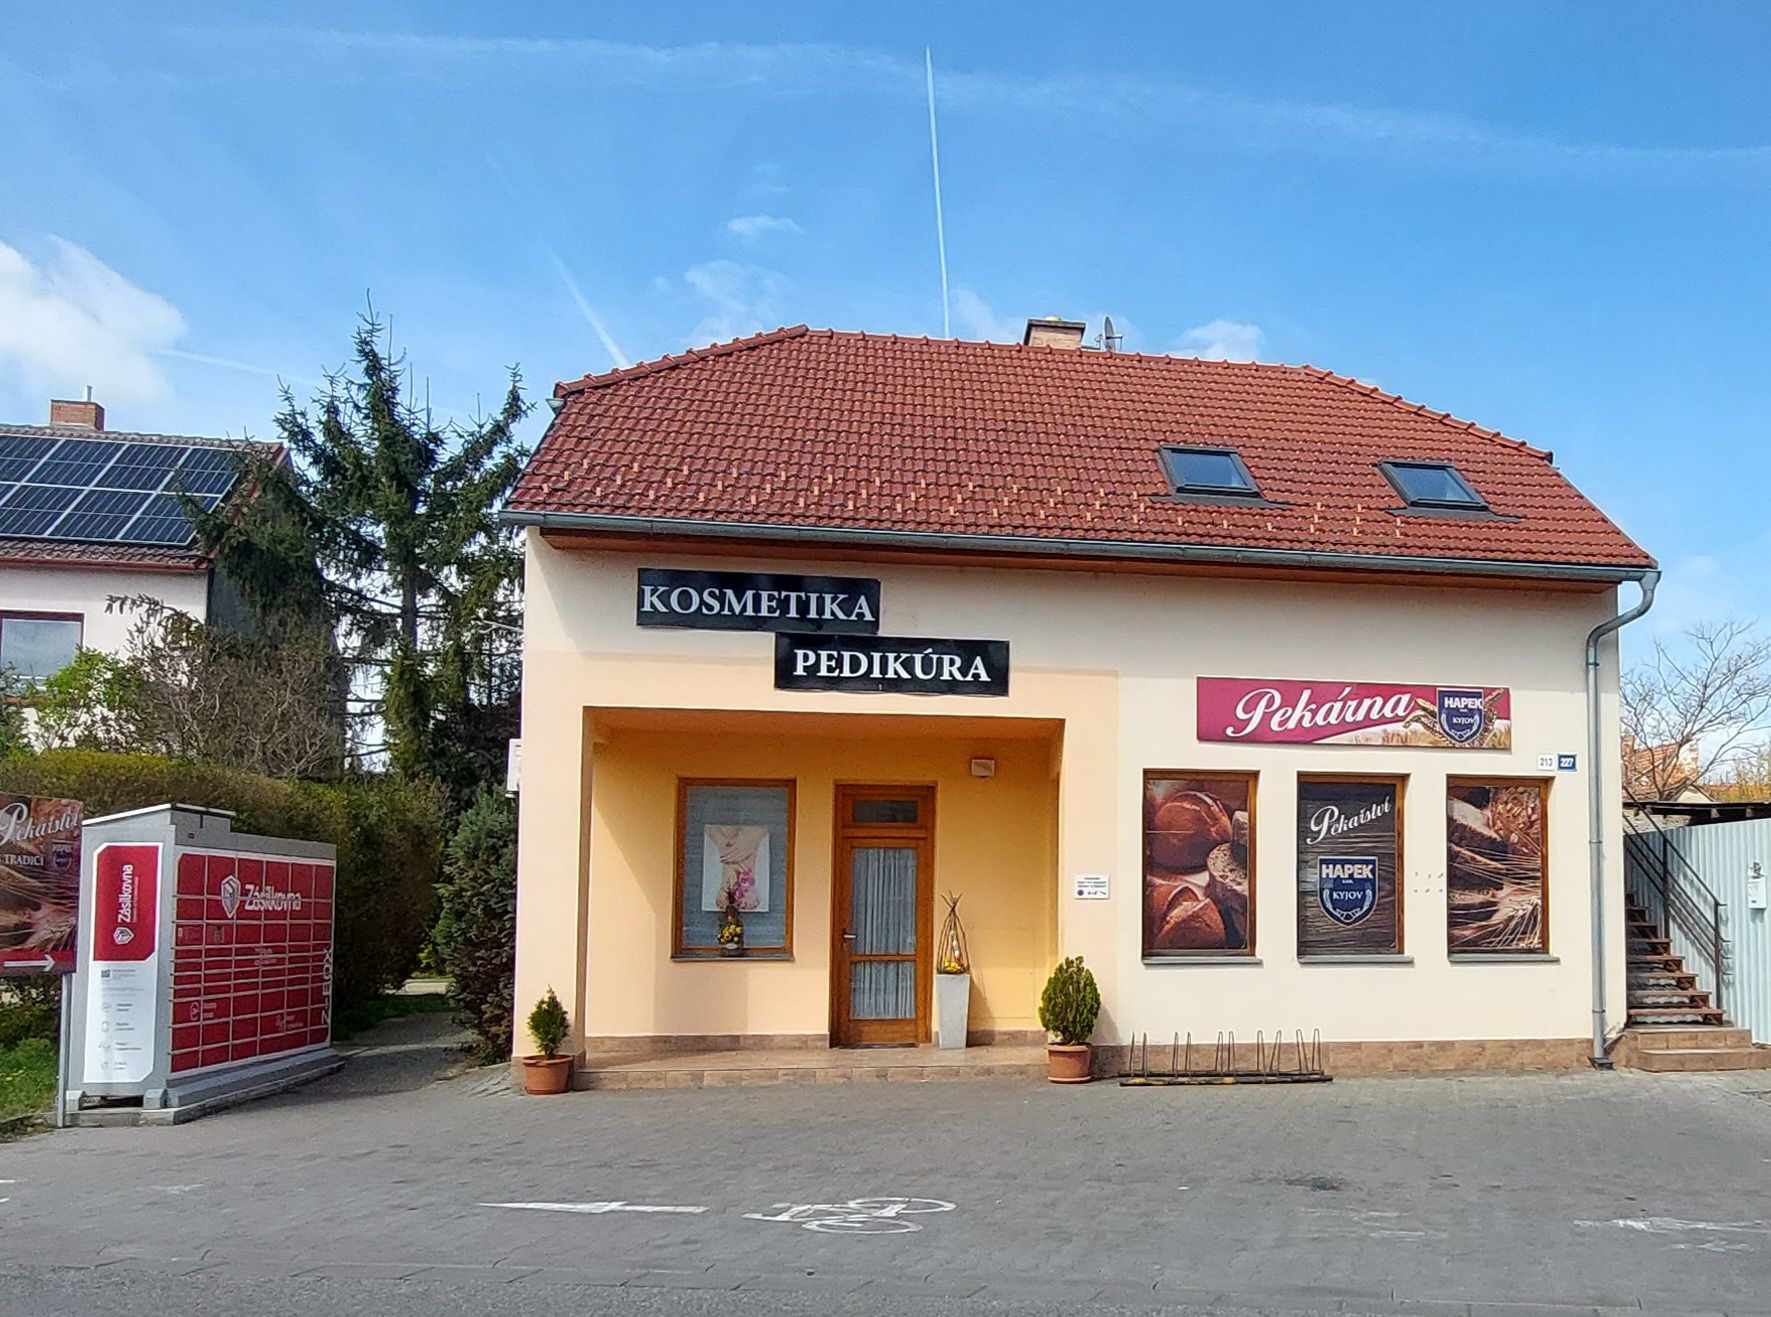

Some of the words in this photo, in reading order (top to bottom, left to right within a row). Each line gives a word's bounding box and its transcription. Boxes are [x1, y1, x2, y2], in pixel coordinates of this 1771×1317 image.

[640, 585, 876, 622] KOSMETIKA
[793, 648, 992, 682] PEDIKÚRA
[1225, 687, 1414, 737] Pekárna
[1444, 696, 1483, 709] HAPEK
[1306, 795, 1391, 844] Pekařství
[1321, 863, 1374, 878] HAPEK
[117, 864, 134, 923] Zásilkovna
[244, 884, 301, 910] Zásilkovna
[1333, 891, 1363, 902] KYJOV
